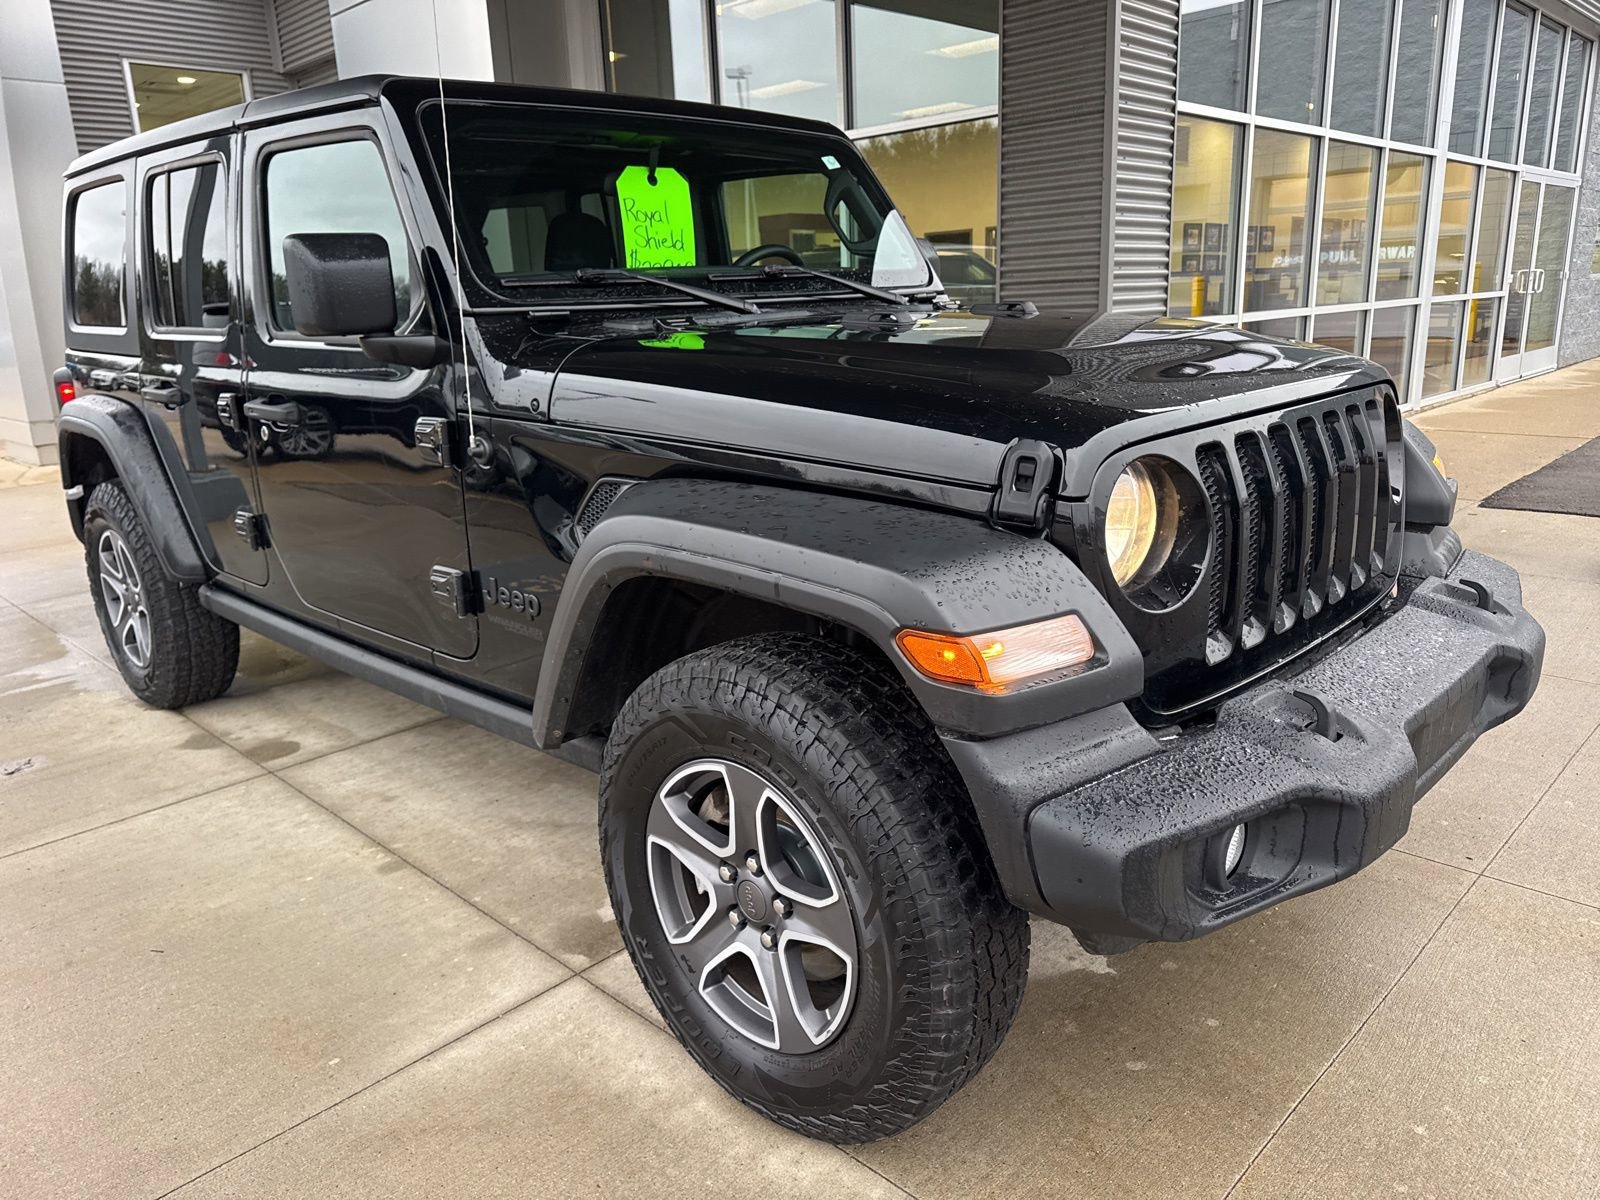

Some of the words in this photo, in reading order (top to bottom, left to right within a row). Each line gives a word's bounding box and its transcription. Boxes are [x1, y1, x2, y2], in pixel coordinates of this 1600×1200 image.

[623, 197, 670, 227] Royal
[633, 225, 685, 252] Shield
[483, 577, 541, 621] Jeep
